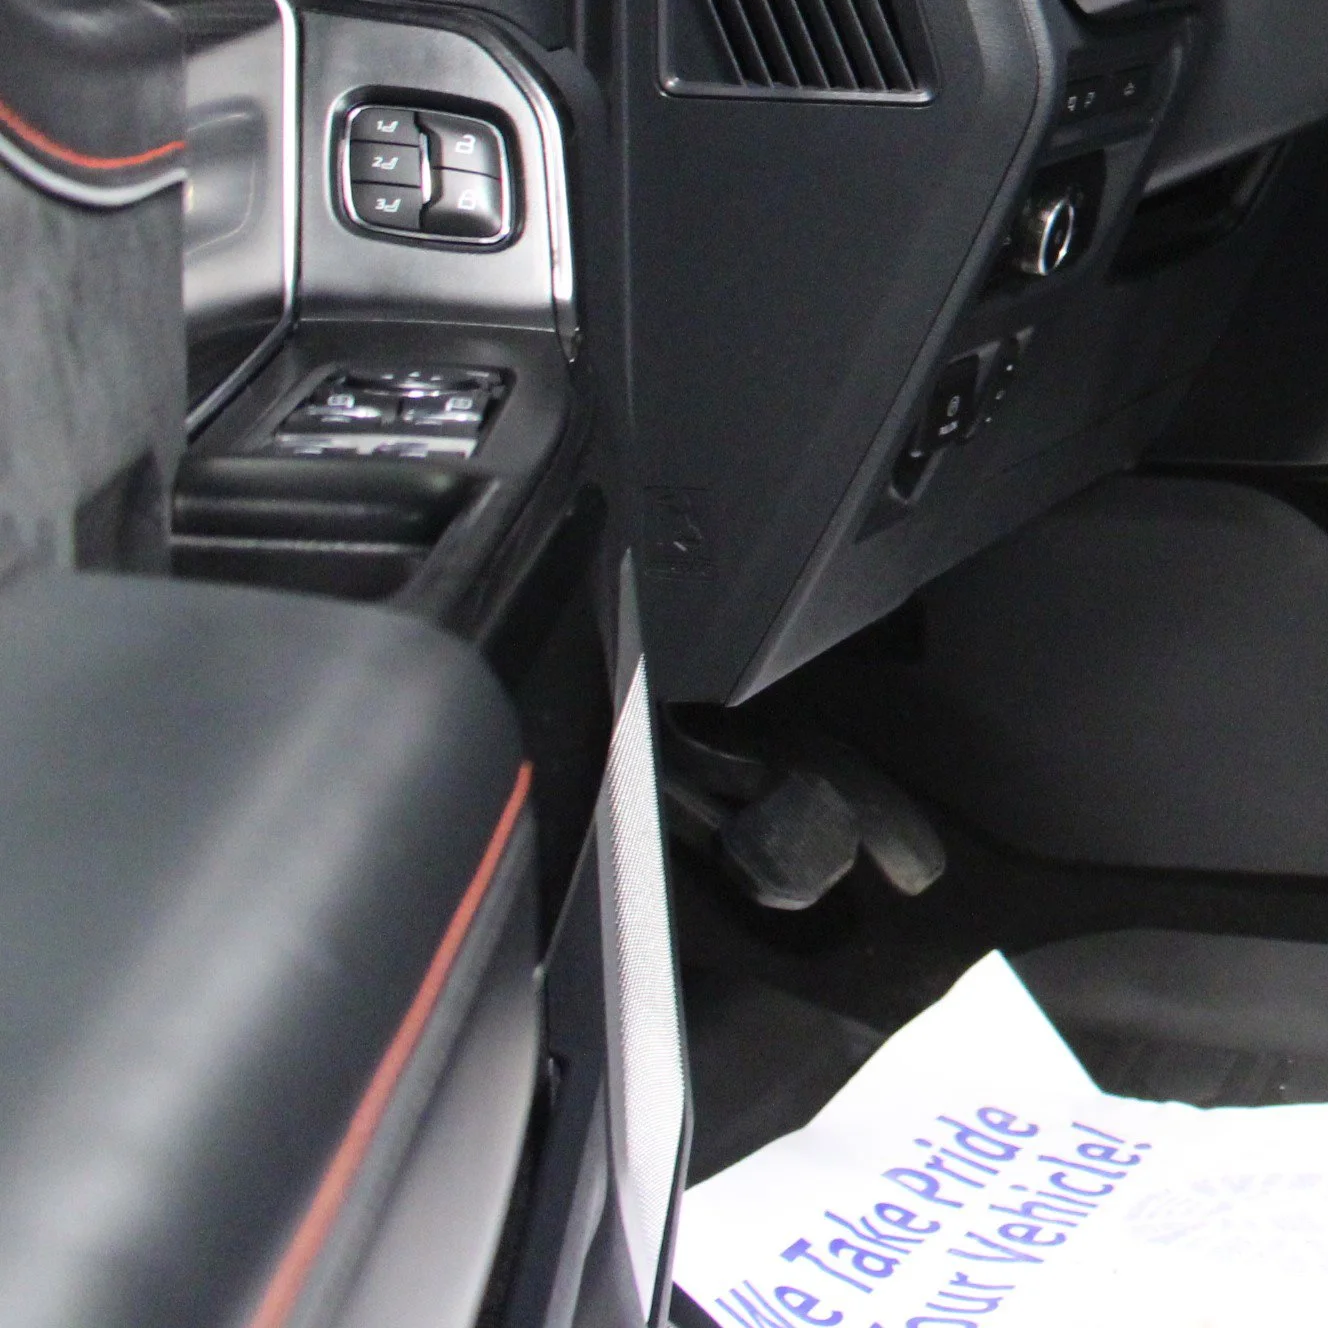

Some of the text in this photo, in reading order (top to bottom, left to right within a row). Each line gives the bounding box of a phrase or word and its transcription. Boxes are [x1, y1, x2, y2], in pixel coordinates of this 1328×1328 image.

[375, 198, 385, 210] 3
[780, 1201, 941, 1294] Take
[881, 1105, 1040, 1209] Pride
[869, 1121, 1153, 1328] our Vehicle!
